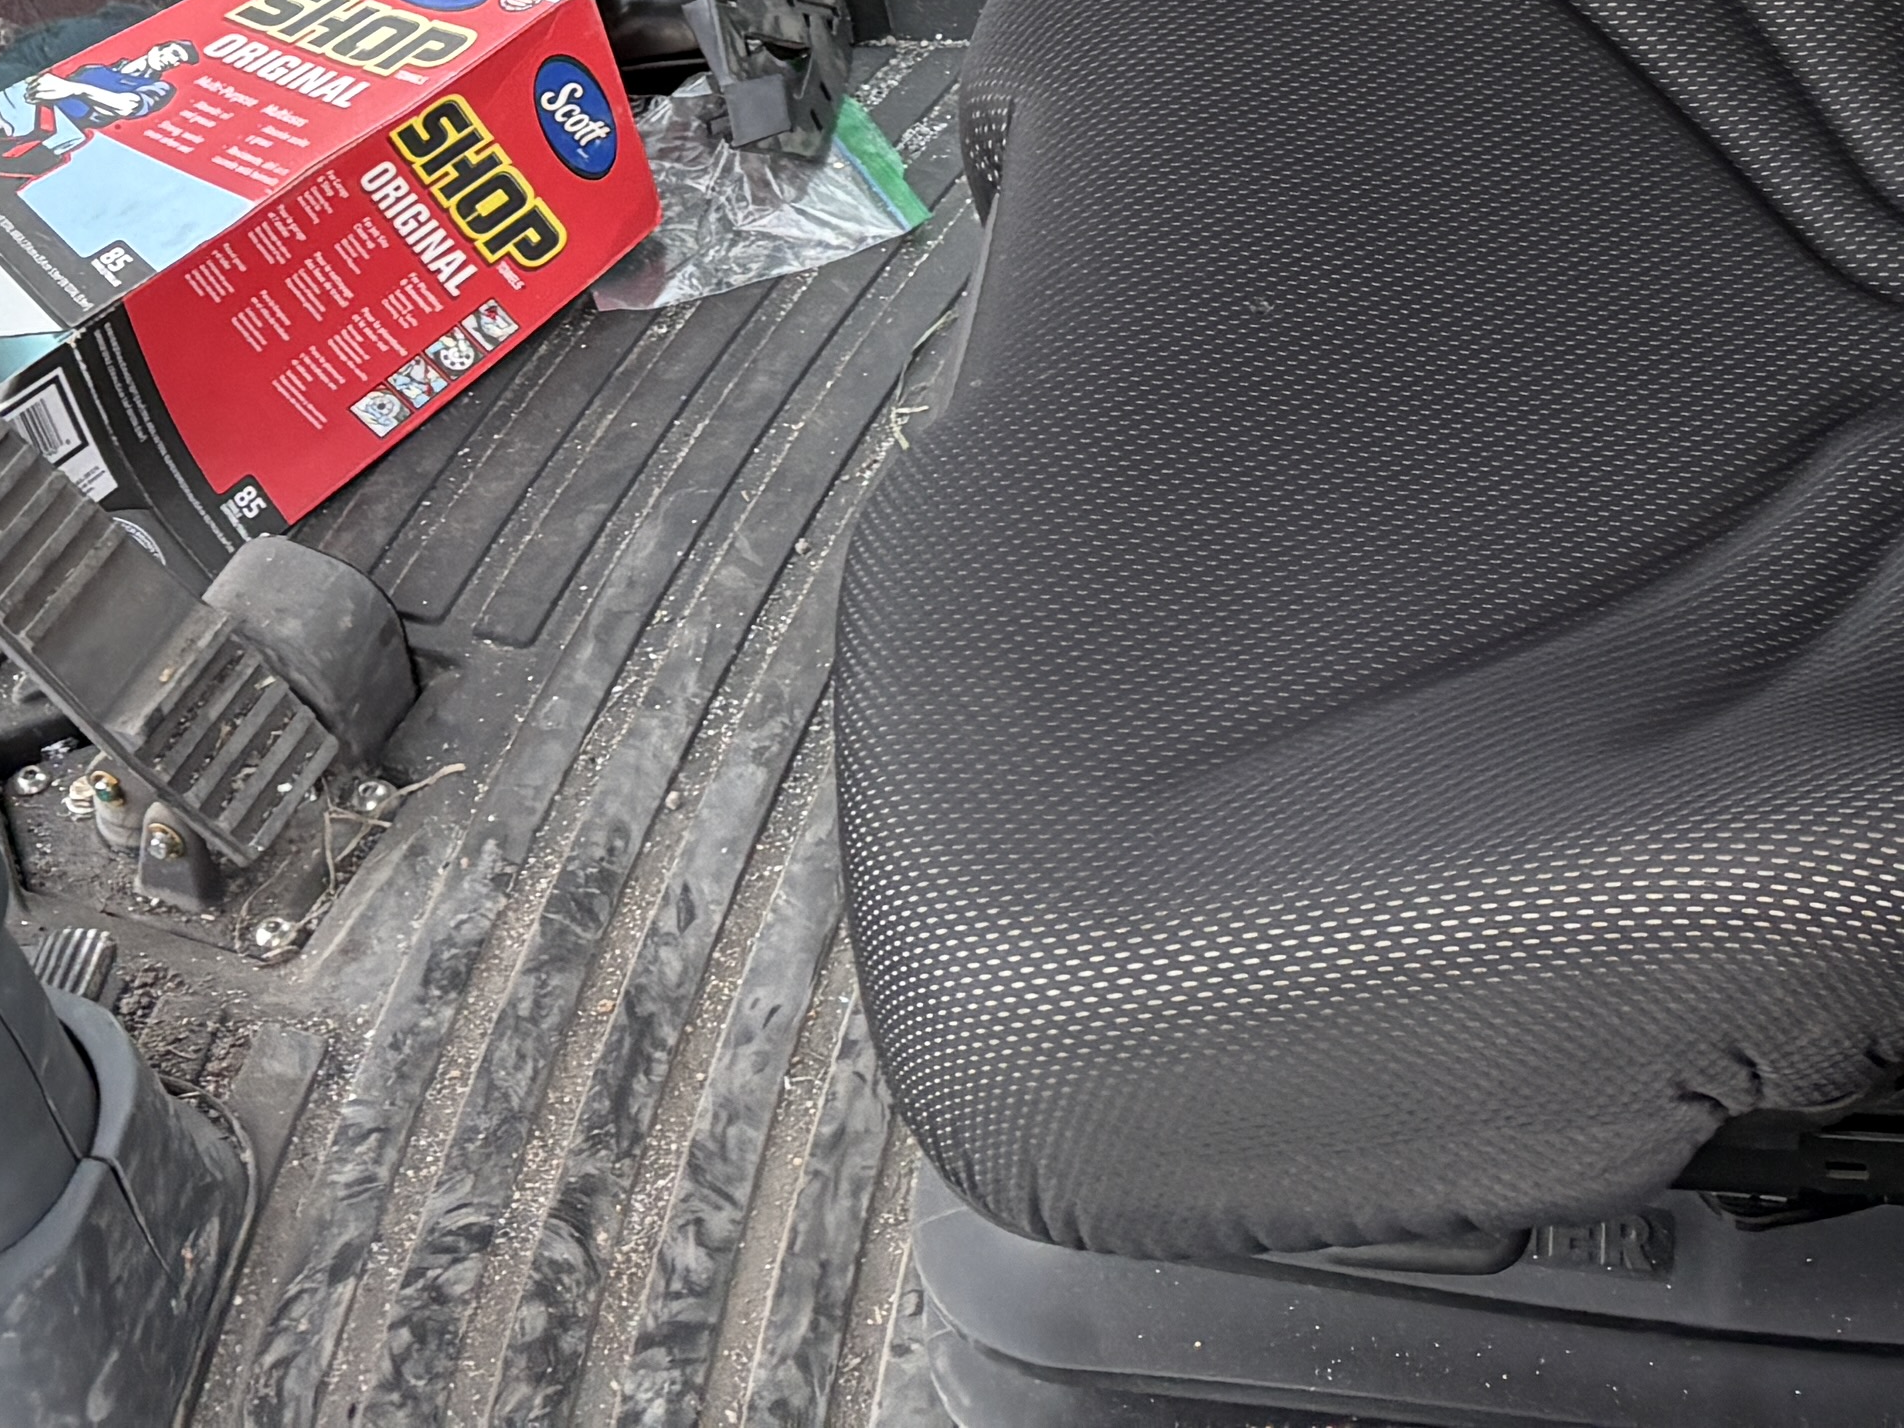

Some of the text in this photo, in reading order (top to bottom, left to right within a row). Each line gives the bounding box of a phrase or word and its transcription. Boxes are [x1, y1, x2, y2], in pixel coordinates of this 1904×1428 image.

[203, 33, 369, 110] ORIGINAL
[541, 83, 611, 146] Scott
[390, 94, 567, 267] SHOP
[100, 247, 134, 272] 85
[360, 160, 477, 300] ORIGINAL
[234, 485, 267, 518] 85
